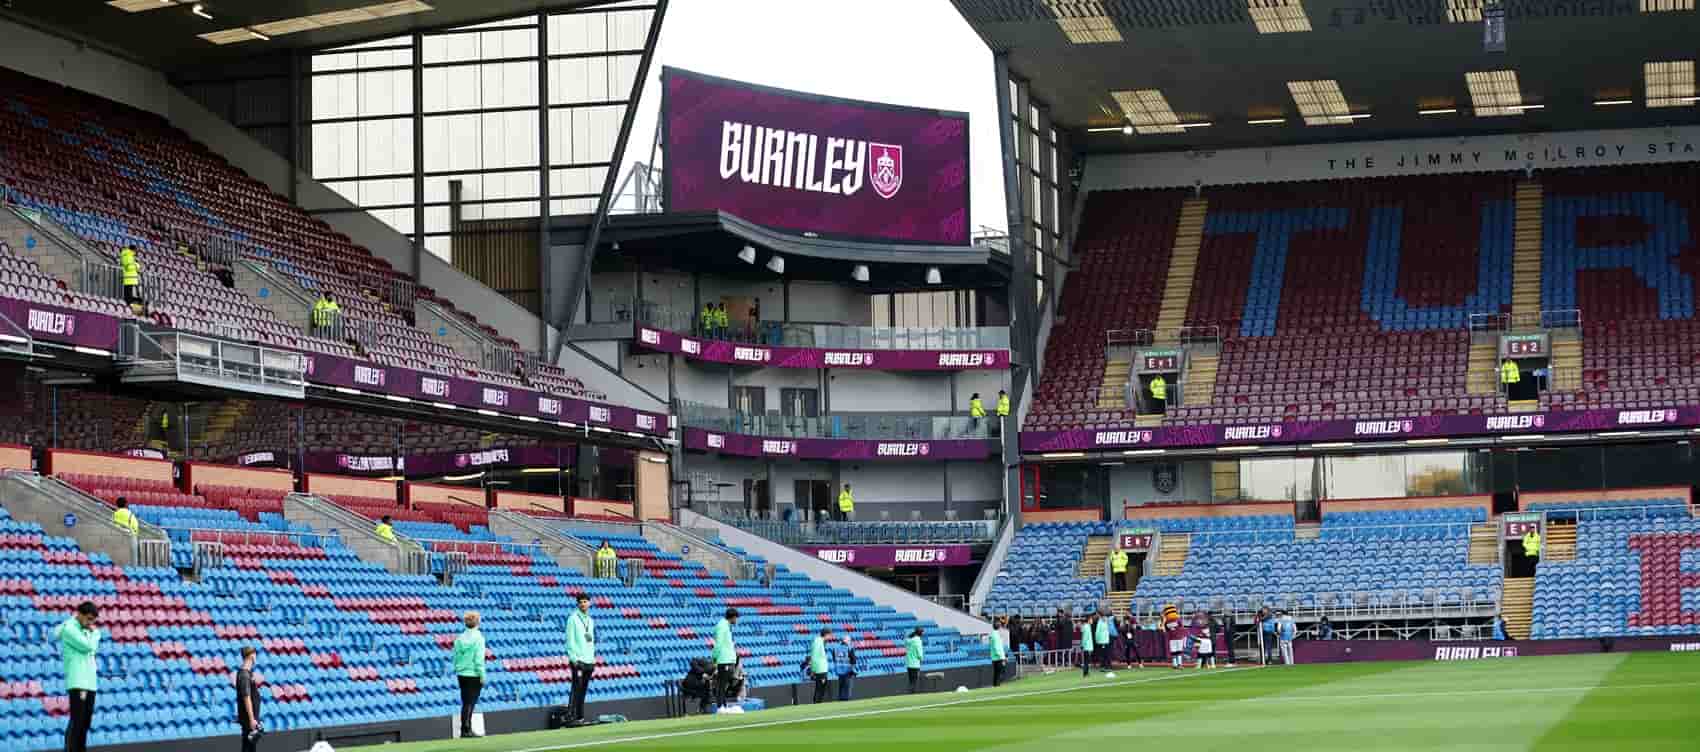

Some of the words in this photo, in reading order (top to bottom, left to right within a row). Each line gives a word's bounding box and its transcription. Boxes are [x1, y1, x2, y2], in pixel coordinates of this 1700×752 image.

[719, 120, 867, 195] BURNLEY
[1328, 157, 1376, 169] THE
[1397, 152, 1481, 167] JIMMY
[1648, 142, 1695, 154] STA
[825, 352, 863, 365] BURNLEY
[939, 353, 982, 366] BURNLEY
[1487, 415, 1532, 429] BURNLEY
[1619, 409, 1665, 424] BURNLEY
[1224, 425, 1270, 440] BURNLEY
[1355, 420, 1400, 433] BURNLEY
[1096, 429, 1140, 444] BURNLEY
[877, 443, 918, 456] BURNLEY
[895, 549, 935, 562] BURNLEY
